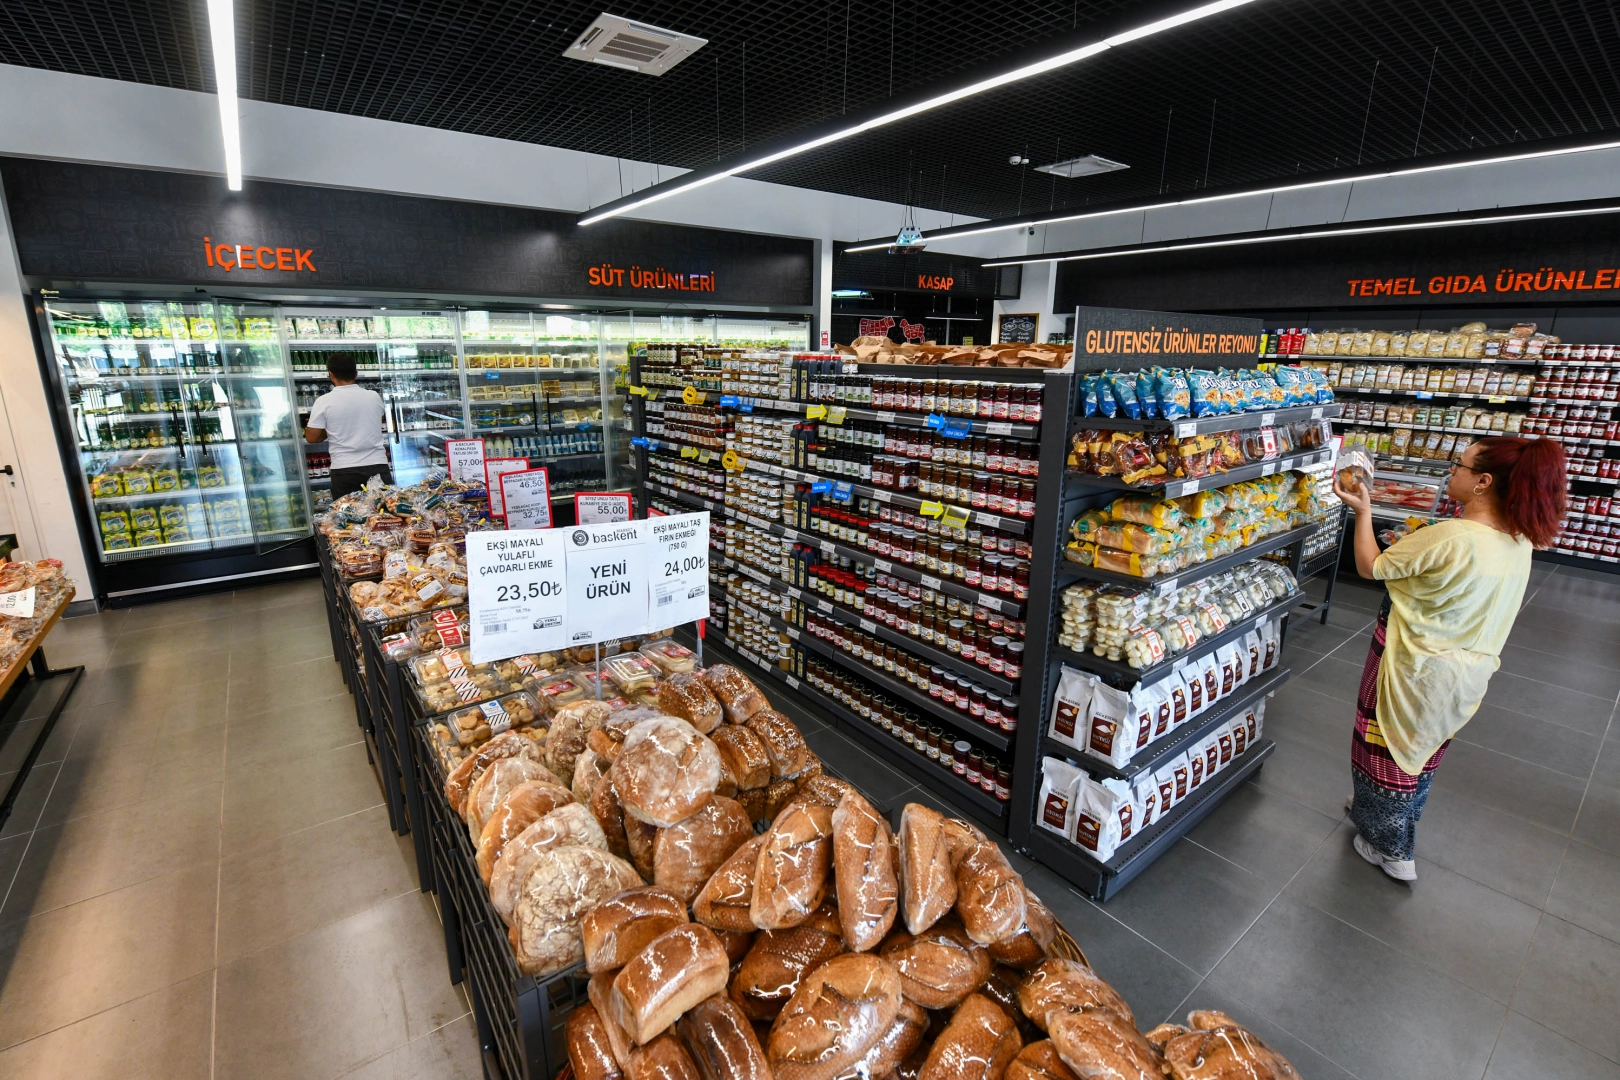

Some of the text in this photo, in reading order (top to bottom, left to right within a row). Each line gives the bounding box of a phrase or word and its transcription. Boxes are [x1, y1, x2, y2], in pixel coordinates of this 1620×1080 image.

[203, 236, 317, 272] İÇECEK
[588, 263, 715, 292] SÜT ÜRÜNLERİ
[918, 274, 954, 290] KASAP
[1348, 267, 1620, 296] TEMEL GIDA ÜRÜNLE
[1085, 326, 1257, 354] GLUTENSİZ ÜRÜNLER REYONU
[653, 518, 701, 534] EKŞİ MAYALI TAŞ
[487, 537, 544, 551] EKŞİ MAYALI
[659, 534, 674, 543] FIRIN
[668, 541, 688, 552] (750 G)
[498, 550, 535, 561] YULAFLI
[479, 559, 553, 577] ÇAVDARLI EKME
[590, 559, 626, 579] YENİ
[664, 556, 706, 577] 24,00₺
[497, 581, 562, 602] 23,50₺
[586, 580, 631, 599] ÜRÜN
